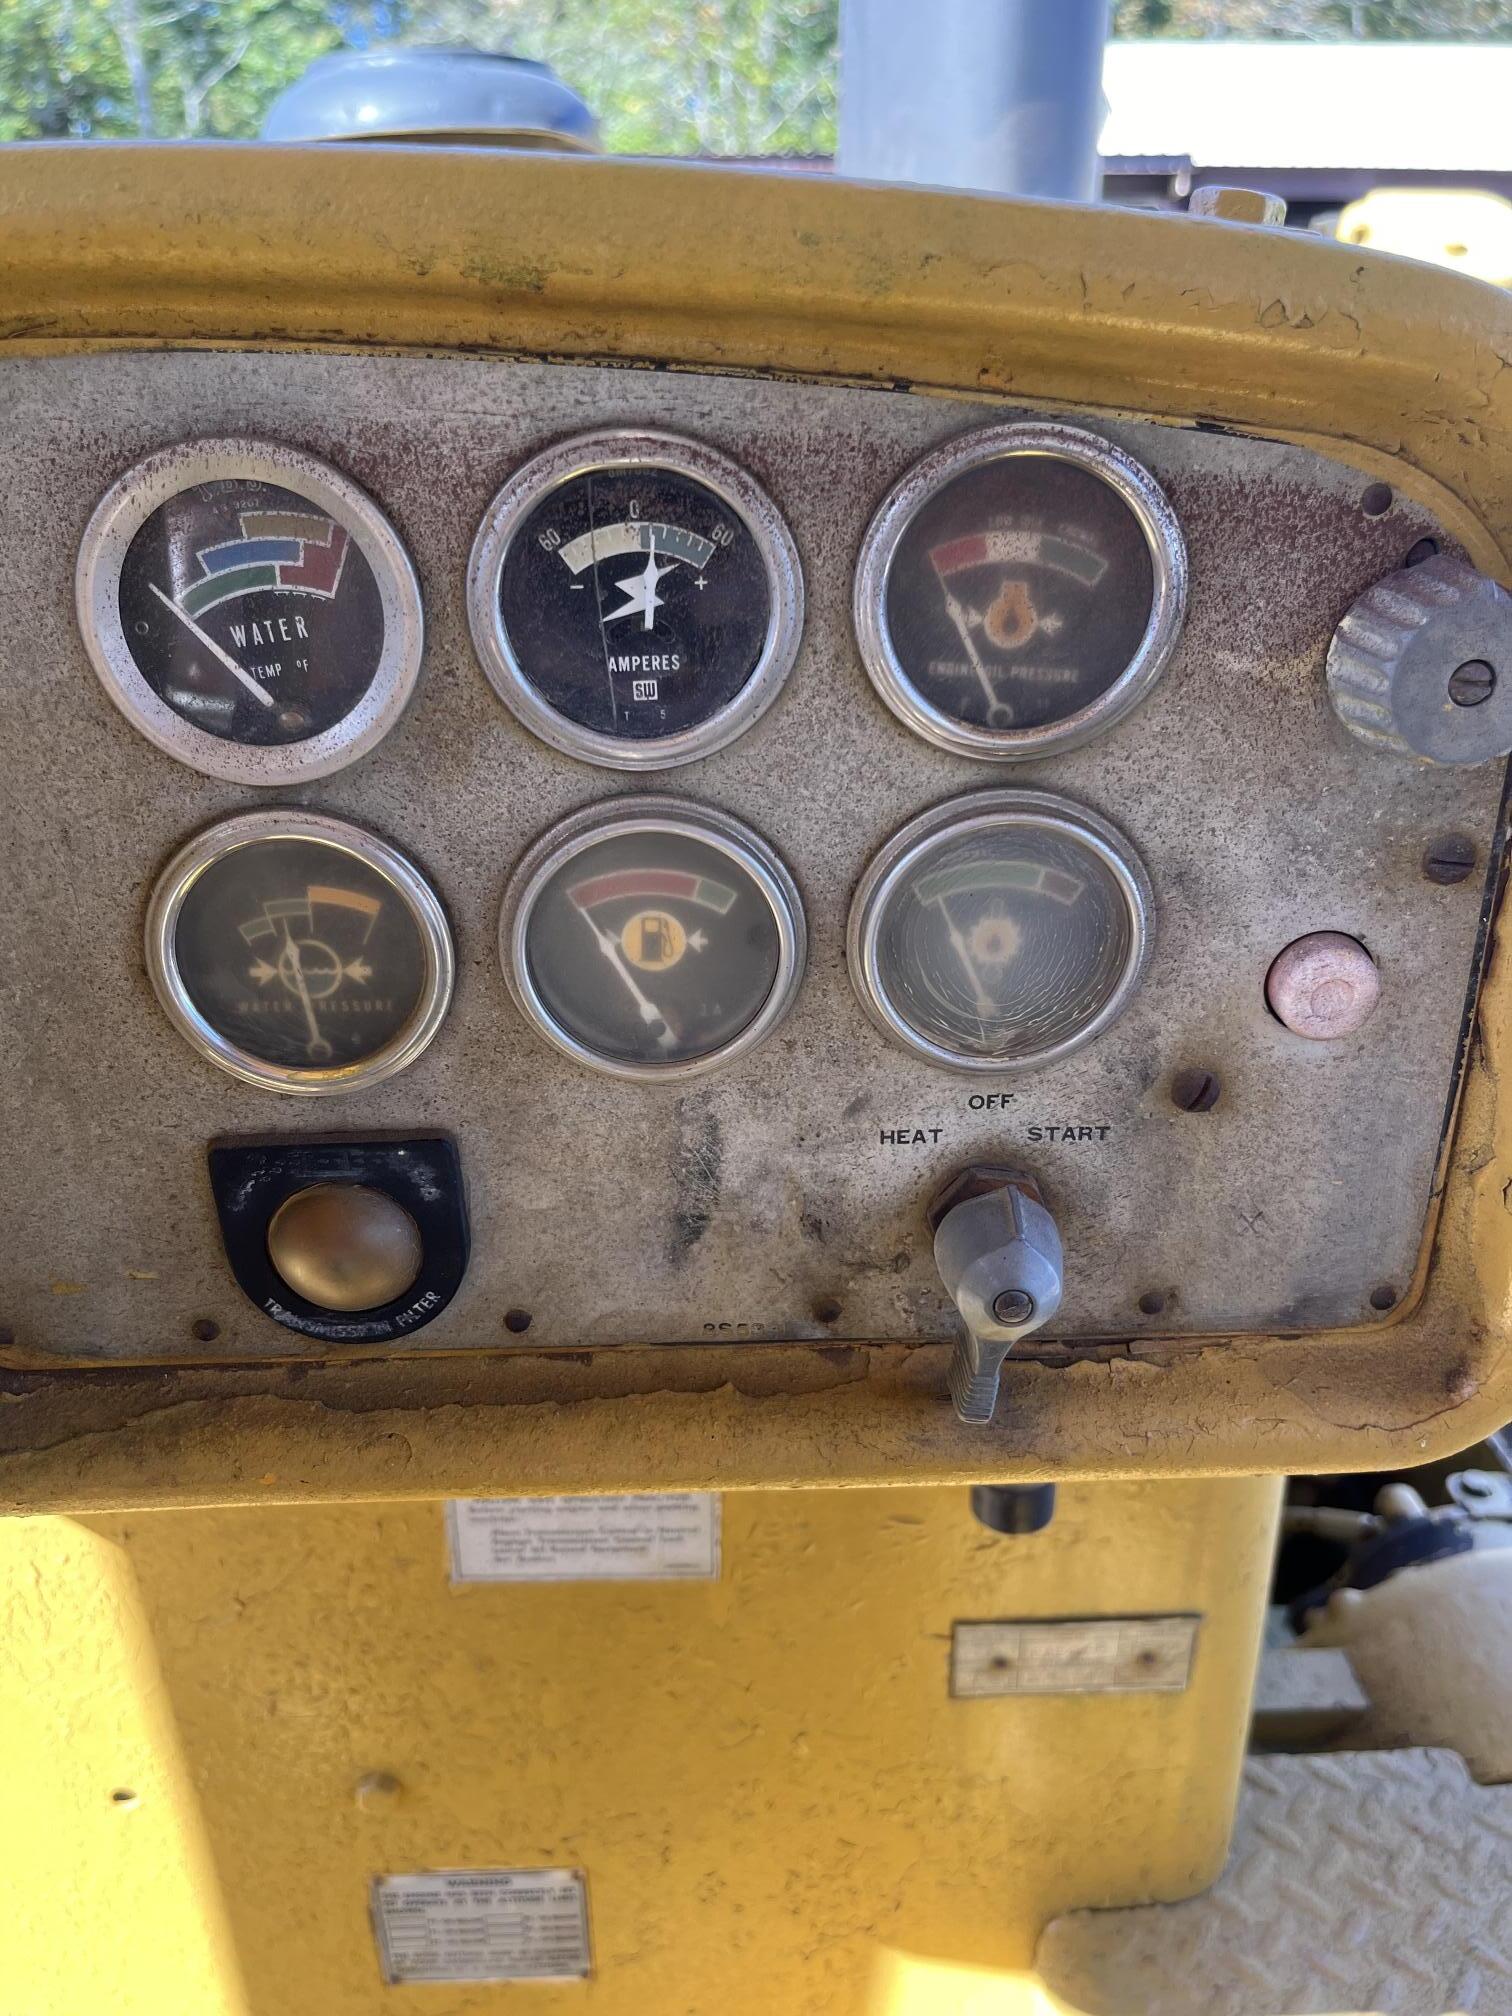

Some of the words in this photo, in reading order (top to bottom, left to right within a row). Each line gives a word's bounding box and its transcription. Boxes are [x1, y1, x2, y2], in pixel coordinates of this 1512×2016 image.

[538, 528, 561, 552] 60
[711, 523, 735, 548] 60
[230, 616, 309, 648] WATER
[251, 663, 282, 680] TEMP
[608, 654, 680, 673] AMPERES
[1010, 664, 1080, 682] PRESSURE
[634, 681, 657, 701] SW
[318, 999, 393, 1013] RESSURE
[968, 1093, 1015, 1110] OFF
[879, 1129, 943, 1145] HEAT
[1027, 1126, 1111, 1142] START
